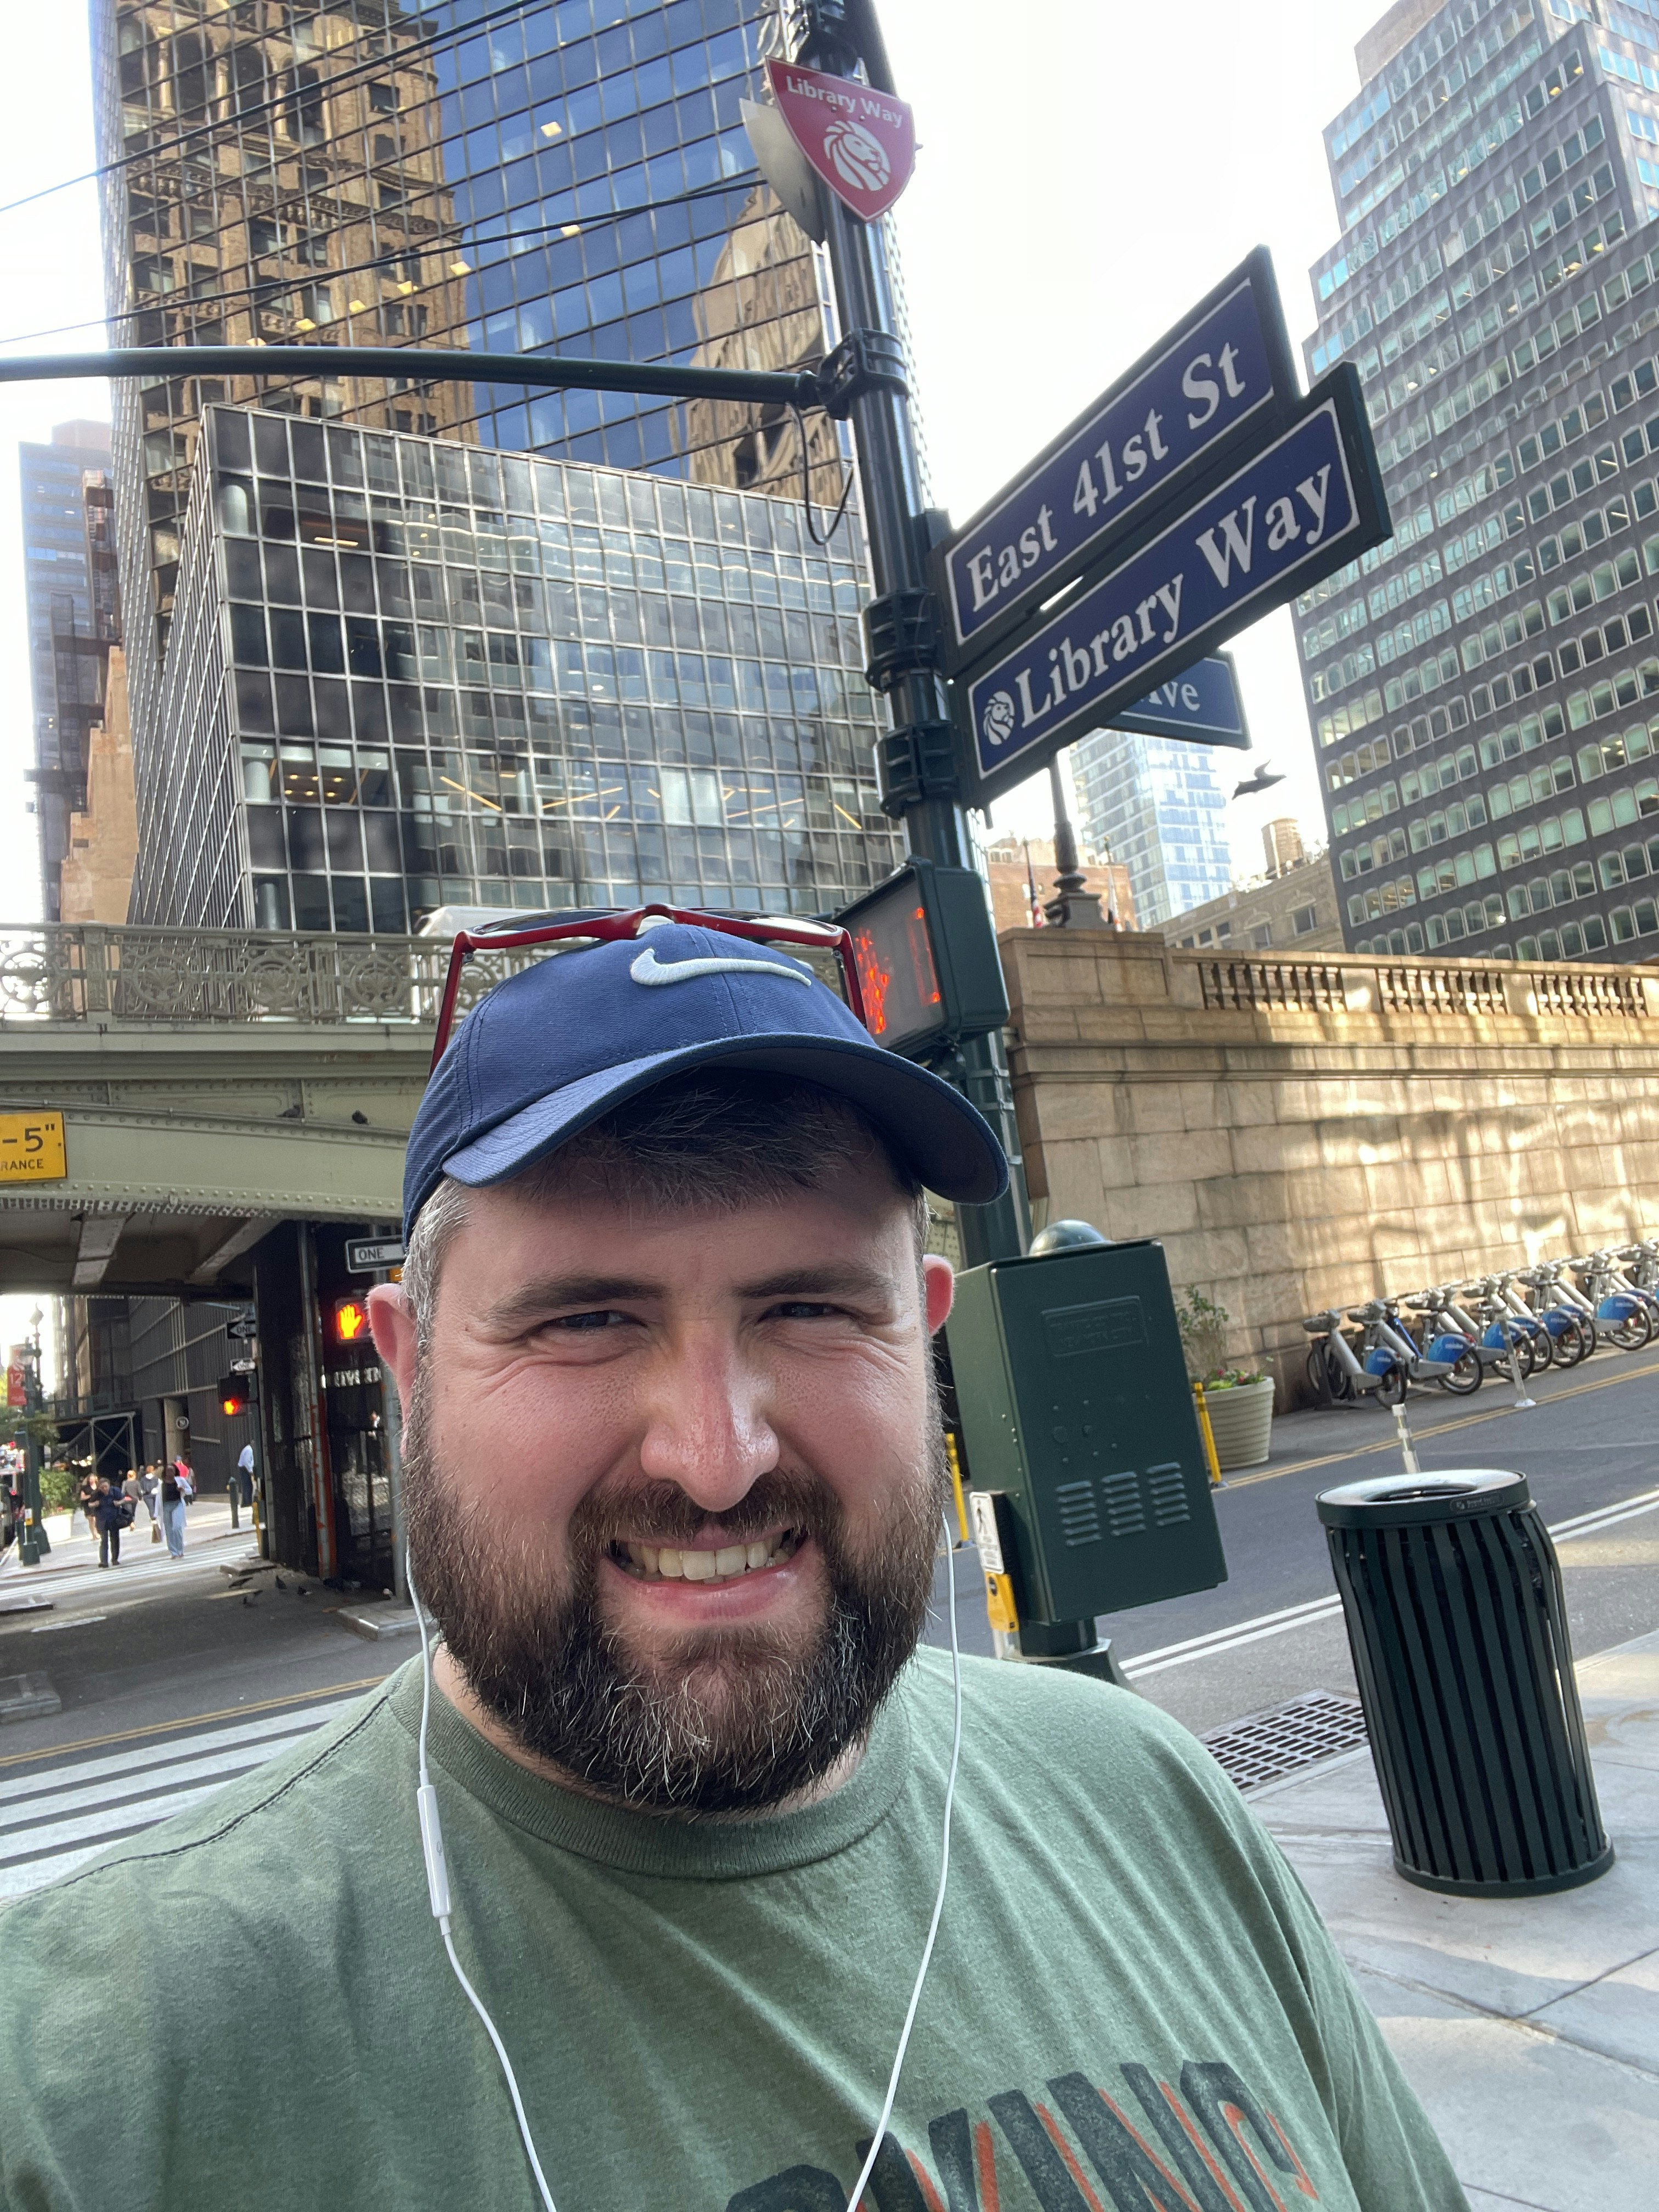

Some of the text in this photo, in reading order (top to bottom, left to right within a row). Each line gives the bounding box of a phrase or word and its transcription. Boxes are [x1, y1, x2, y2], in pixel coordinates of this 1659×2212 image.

[786, 75, 903, 129] Library Way
[966, 342, 1246, 612] East 41st St
[1015, 462, 1332, 729] Library Way
[358, 1246, 385, 1261] ONE
